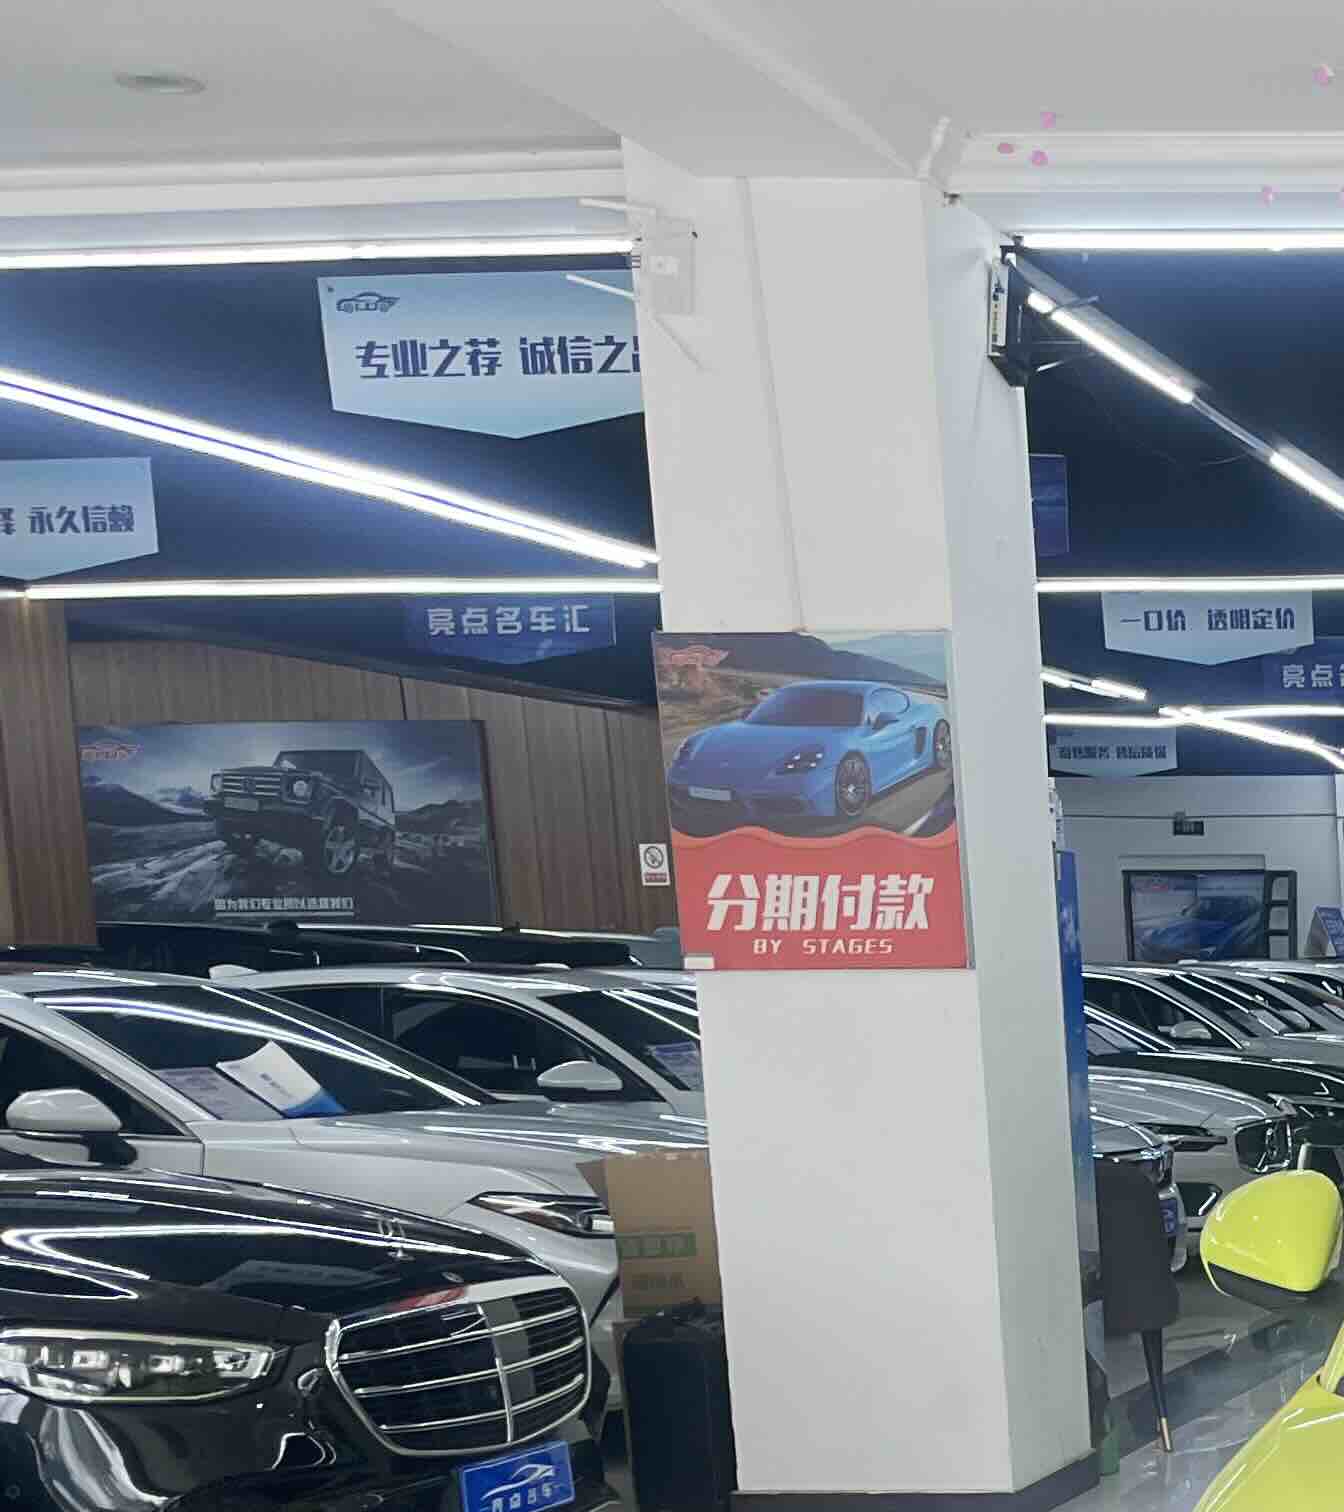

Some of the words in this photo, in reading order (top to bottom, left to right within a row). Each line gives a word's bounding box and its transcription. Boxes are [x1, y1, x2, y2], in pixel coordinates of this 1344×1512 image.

[355, 340, 502, 379] 专业之荐
[519, 335, 640, 377] 诚信之
[28, 504, 135, 534] 永久信赖
[427, 605, 590, 635] 亮点名车汇
[1120, 609, 1186, 631] 一口价
[1208, 608, 1295, 630] 透明定价
[706, 873, 935, 932] 分期付款
[753, 939, 782, 955] BY
[802, 938, 893, 955] STAGES
